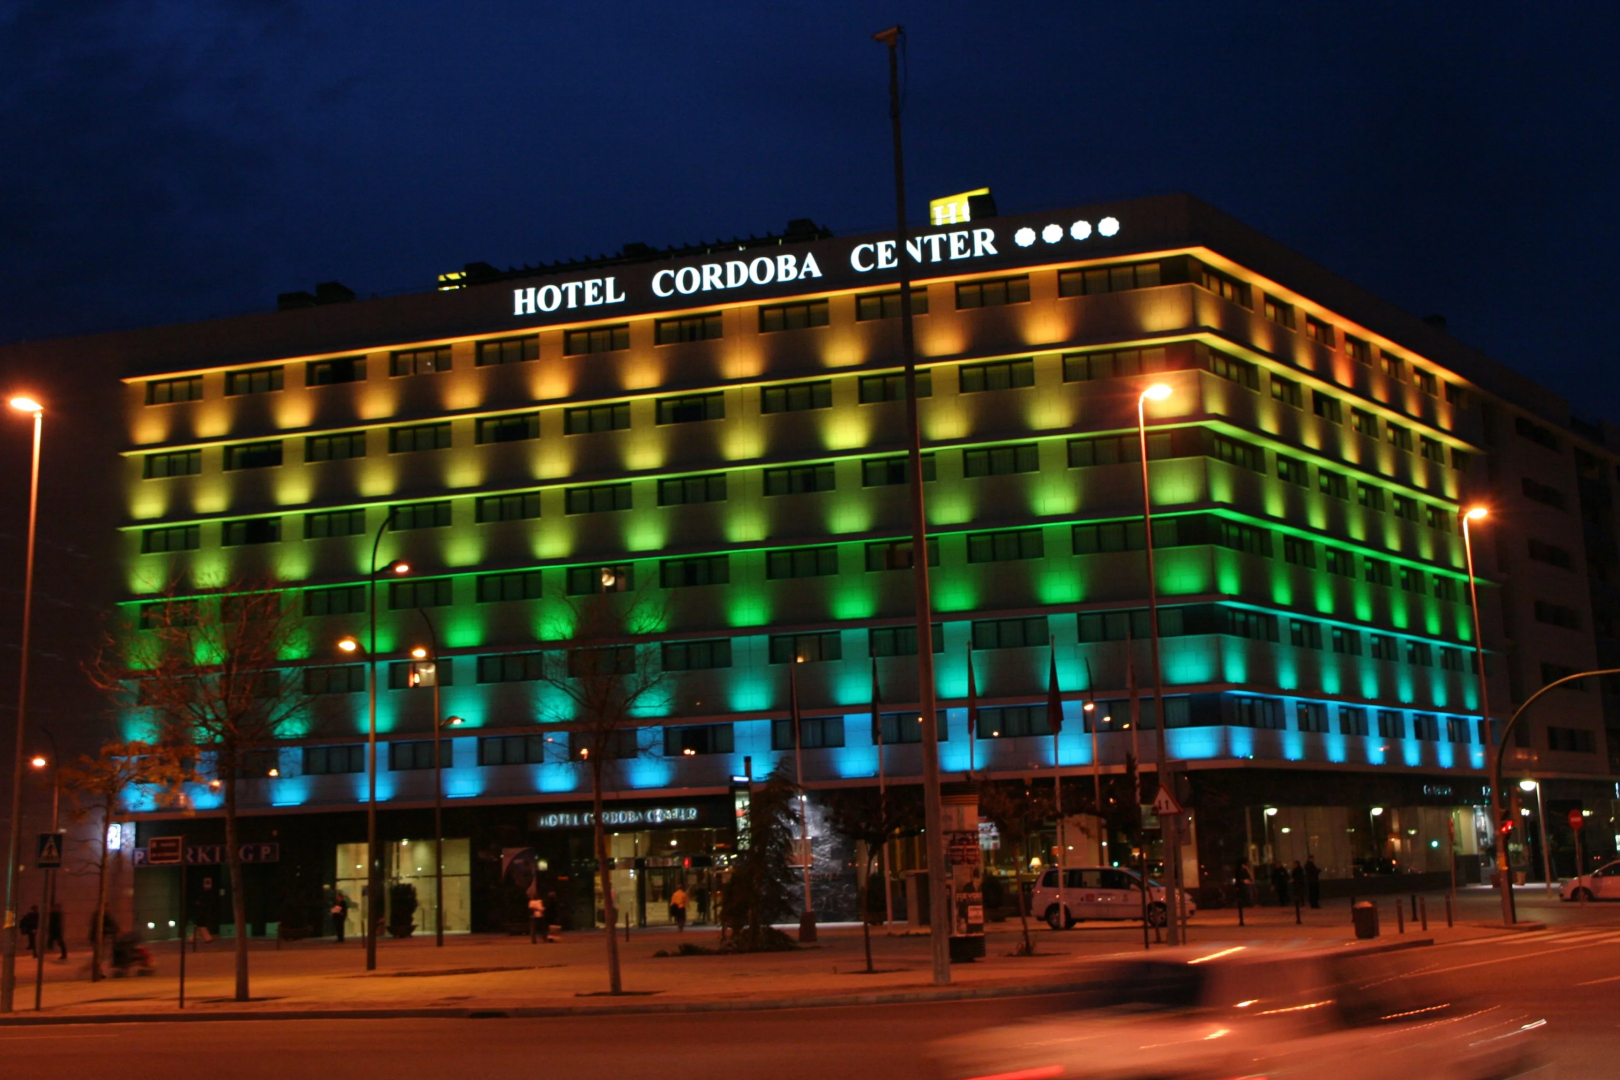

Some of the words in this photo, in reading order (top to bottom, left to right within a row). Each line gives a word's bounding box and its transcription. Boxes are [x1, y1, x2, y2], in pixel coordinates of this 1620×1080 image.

[513, 276, 626, 316] HOTEL
[651, 251, 823, 298] CORDOBA
[849, 227, 999, 273] CENTER
[539, 812, 580, 827] HOTEL
[645, 807, 698, 823] CENTER
